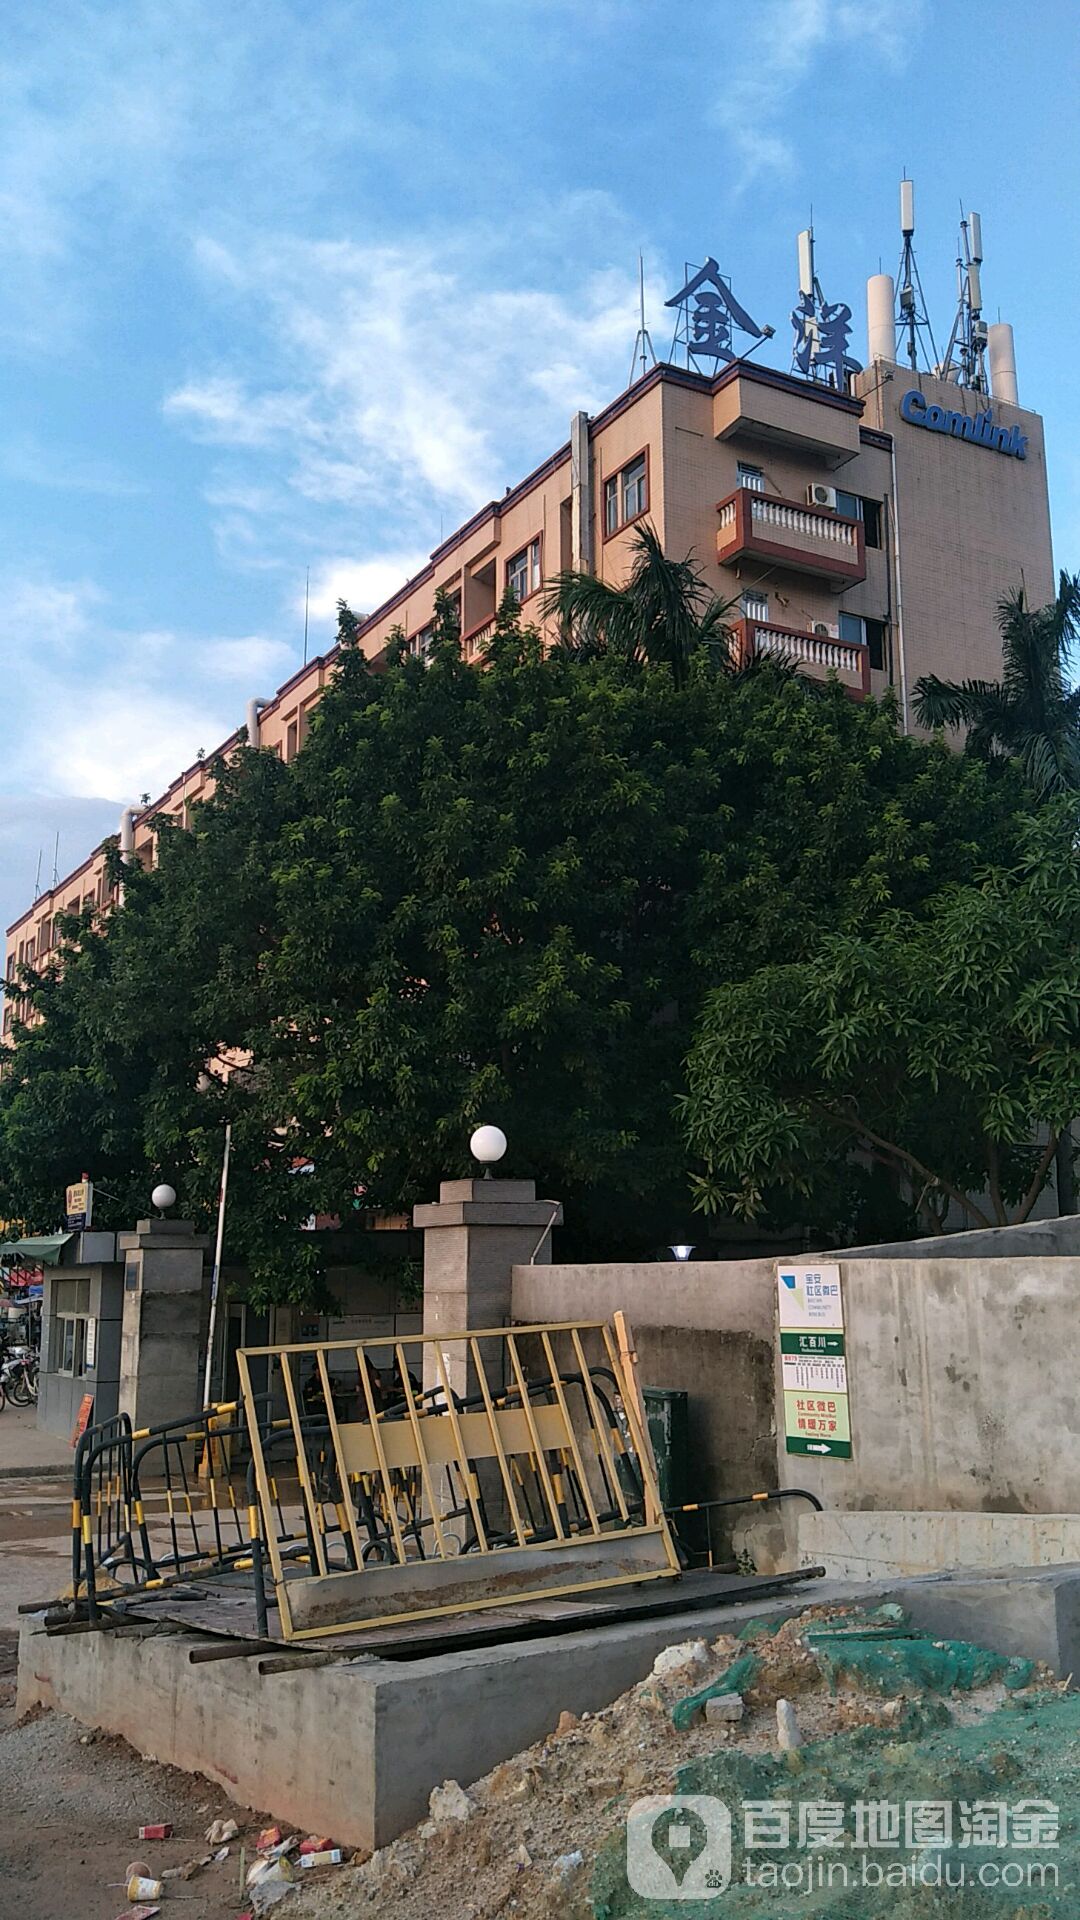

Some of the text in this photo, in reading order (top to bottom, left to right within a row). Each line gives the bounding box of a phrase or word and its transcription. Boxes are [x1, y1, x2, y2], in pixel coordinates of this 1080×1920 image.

[664, 256, 863, 392] 金洋
[900, 388, 1028, 459] Comlink
[805, 1273, 822, 1284] 宝安
[806, 1285, 838, 1296] 社区微巴
[798, 1336, 826, 1348] 汇百川
[797, 1400, 836, 1414] 社区微巴
